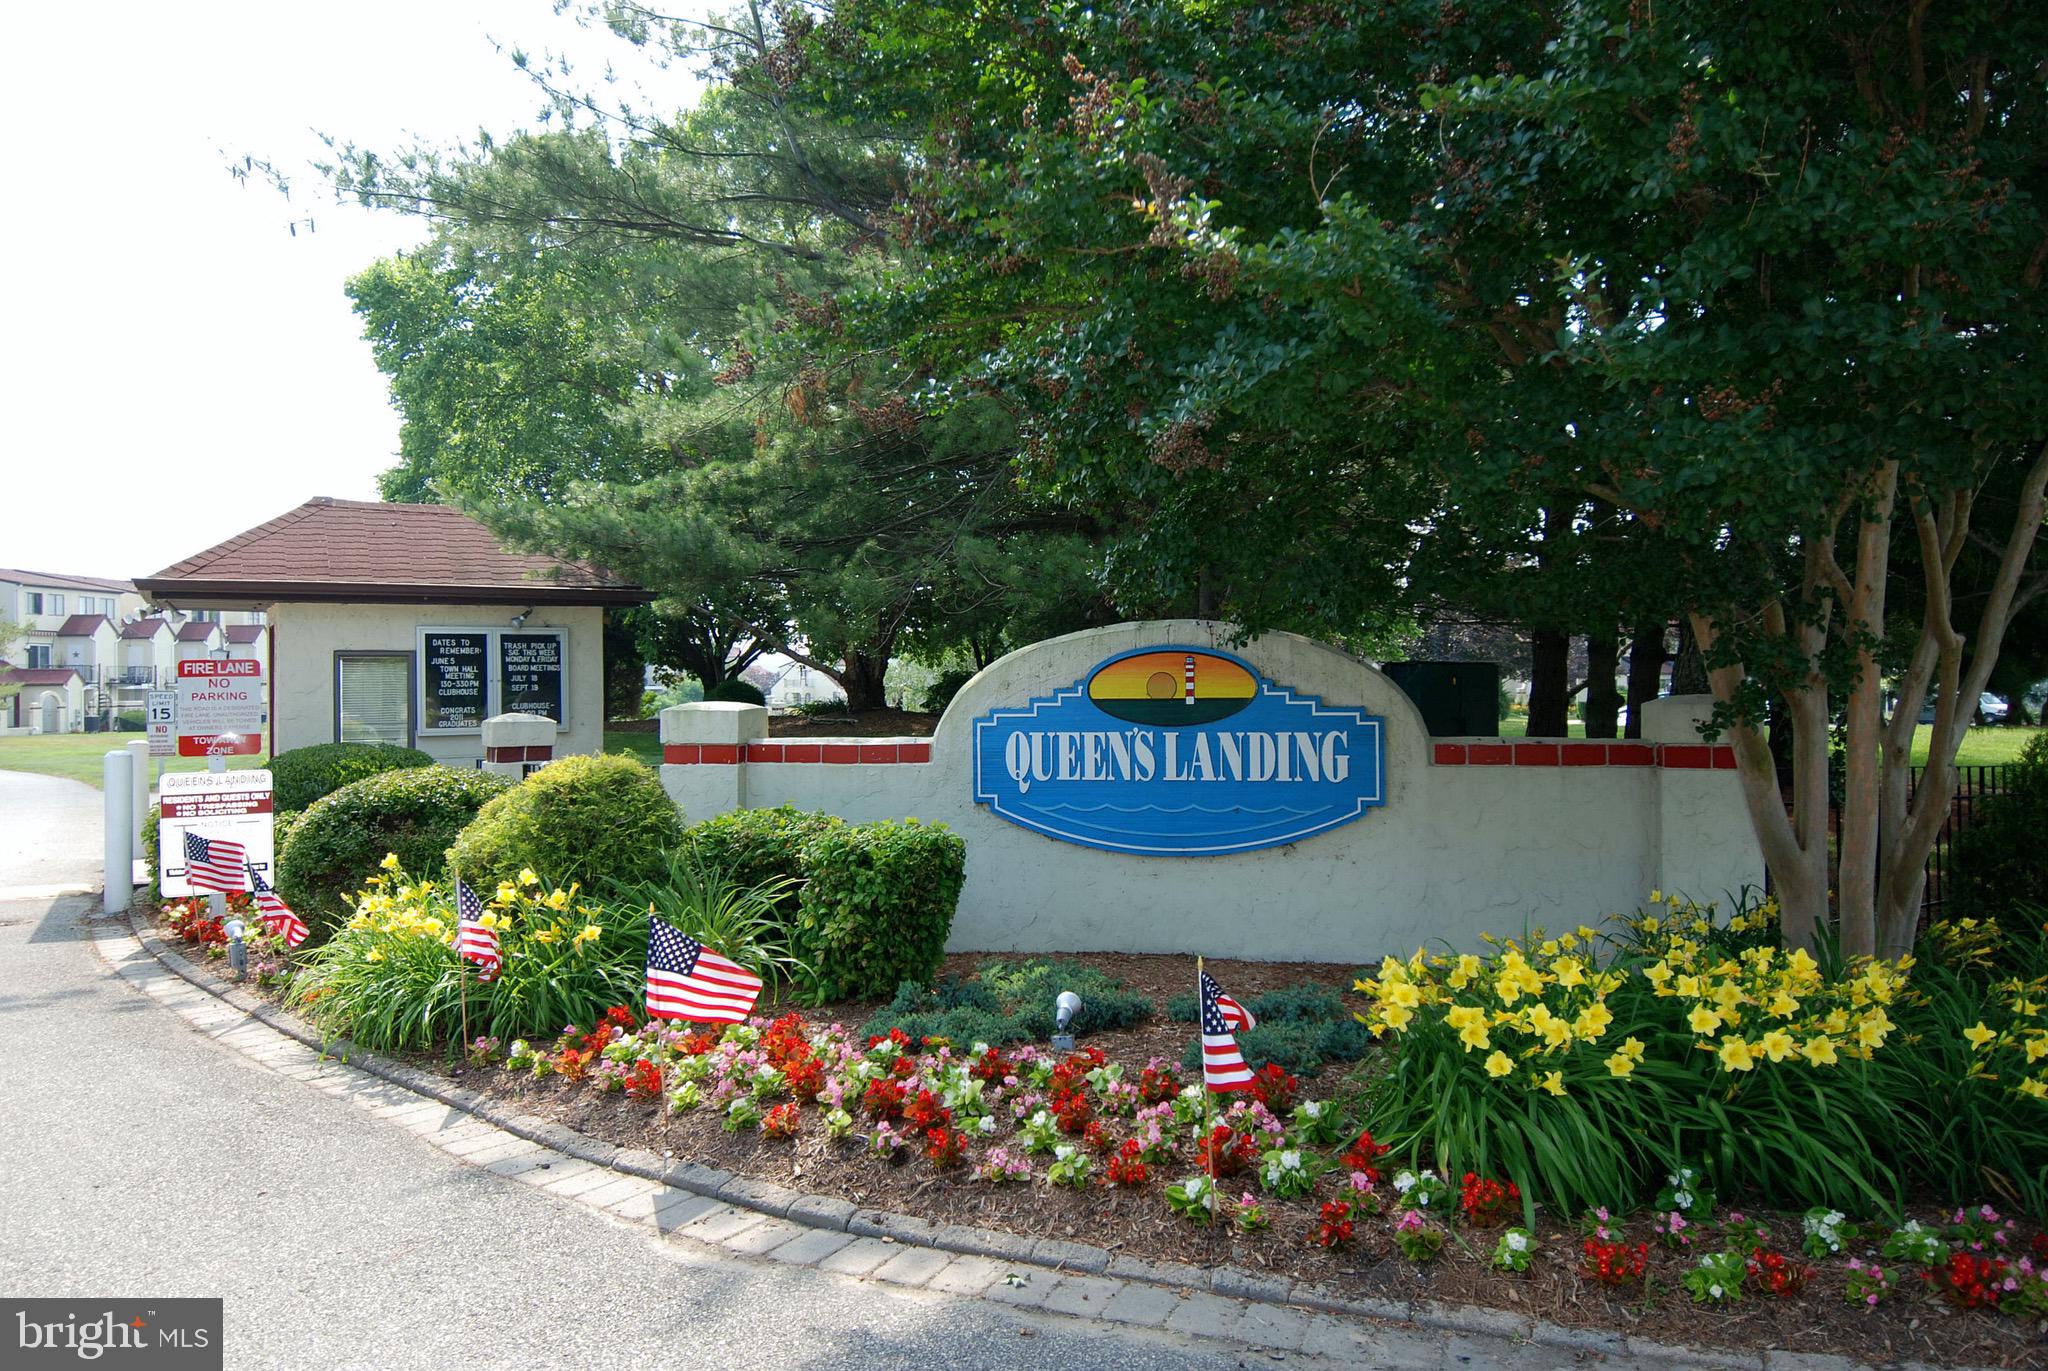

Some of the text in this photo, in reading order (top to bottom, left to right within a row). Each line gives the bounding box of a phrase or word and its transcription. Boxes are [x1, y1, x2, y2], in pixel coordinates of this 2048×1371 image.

[183, 662, 254, 675] FIRE LANE
[208, 678, 231, 688] NO
[191, 691, 248, 701] PARKING
[152, 707, 171, 720] 15
[441, 707, 477, 715] CONGRATS
[155, 725, 168, 734] NO
[206, 746, 235, 755] ZONE
[1005, 727, 1351, 794] QUEEN'S LANDING
[166, 773, 268, 788] QUEENS LANDING
[162, 791, 271, 805] RESIDENTS AND GUESTS ONLY
[197, 801, 259, 810] TRESPASSING
[197, 807, 248, 816] SOLICITING
